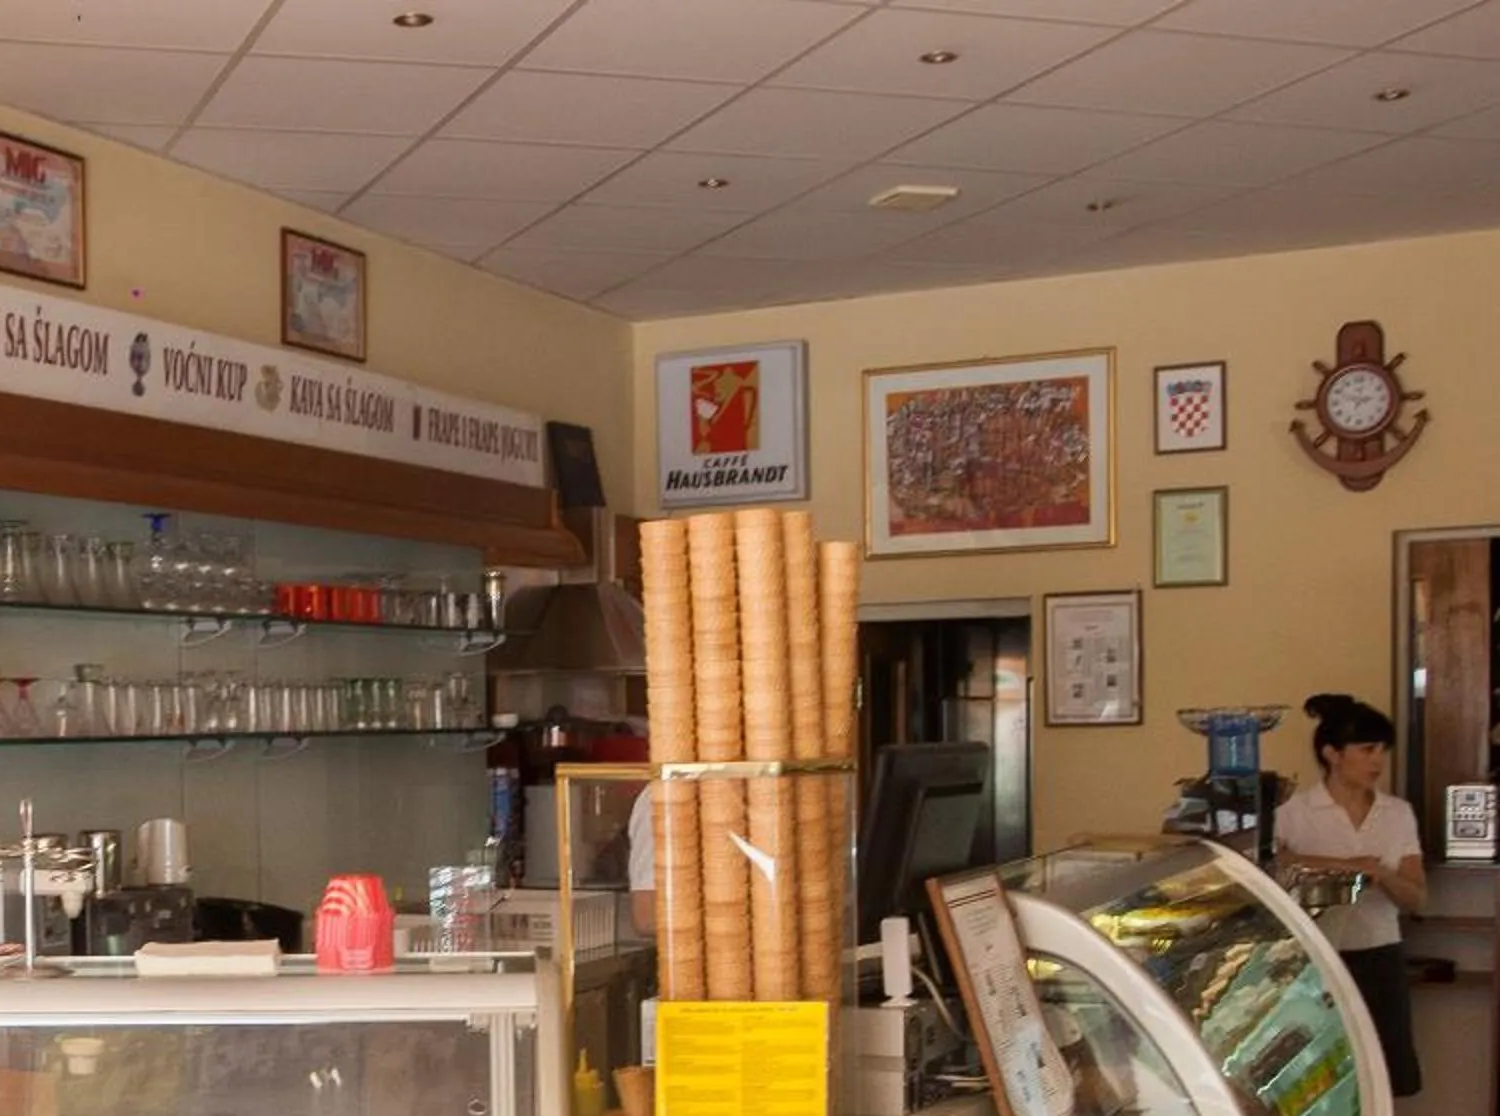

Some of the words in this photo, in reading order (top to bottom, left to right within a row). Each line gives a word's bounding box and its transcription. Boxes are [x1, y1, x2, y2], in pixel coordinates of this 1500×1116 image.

[5, 313, 28, 360] SA
[163, 341, 212, 394] VOĆNI
[215, 358, 248, 402] KUP
[290, 375, 323, 418] KAVA
[326, 384, 342, 423] SA
